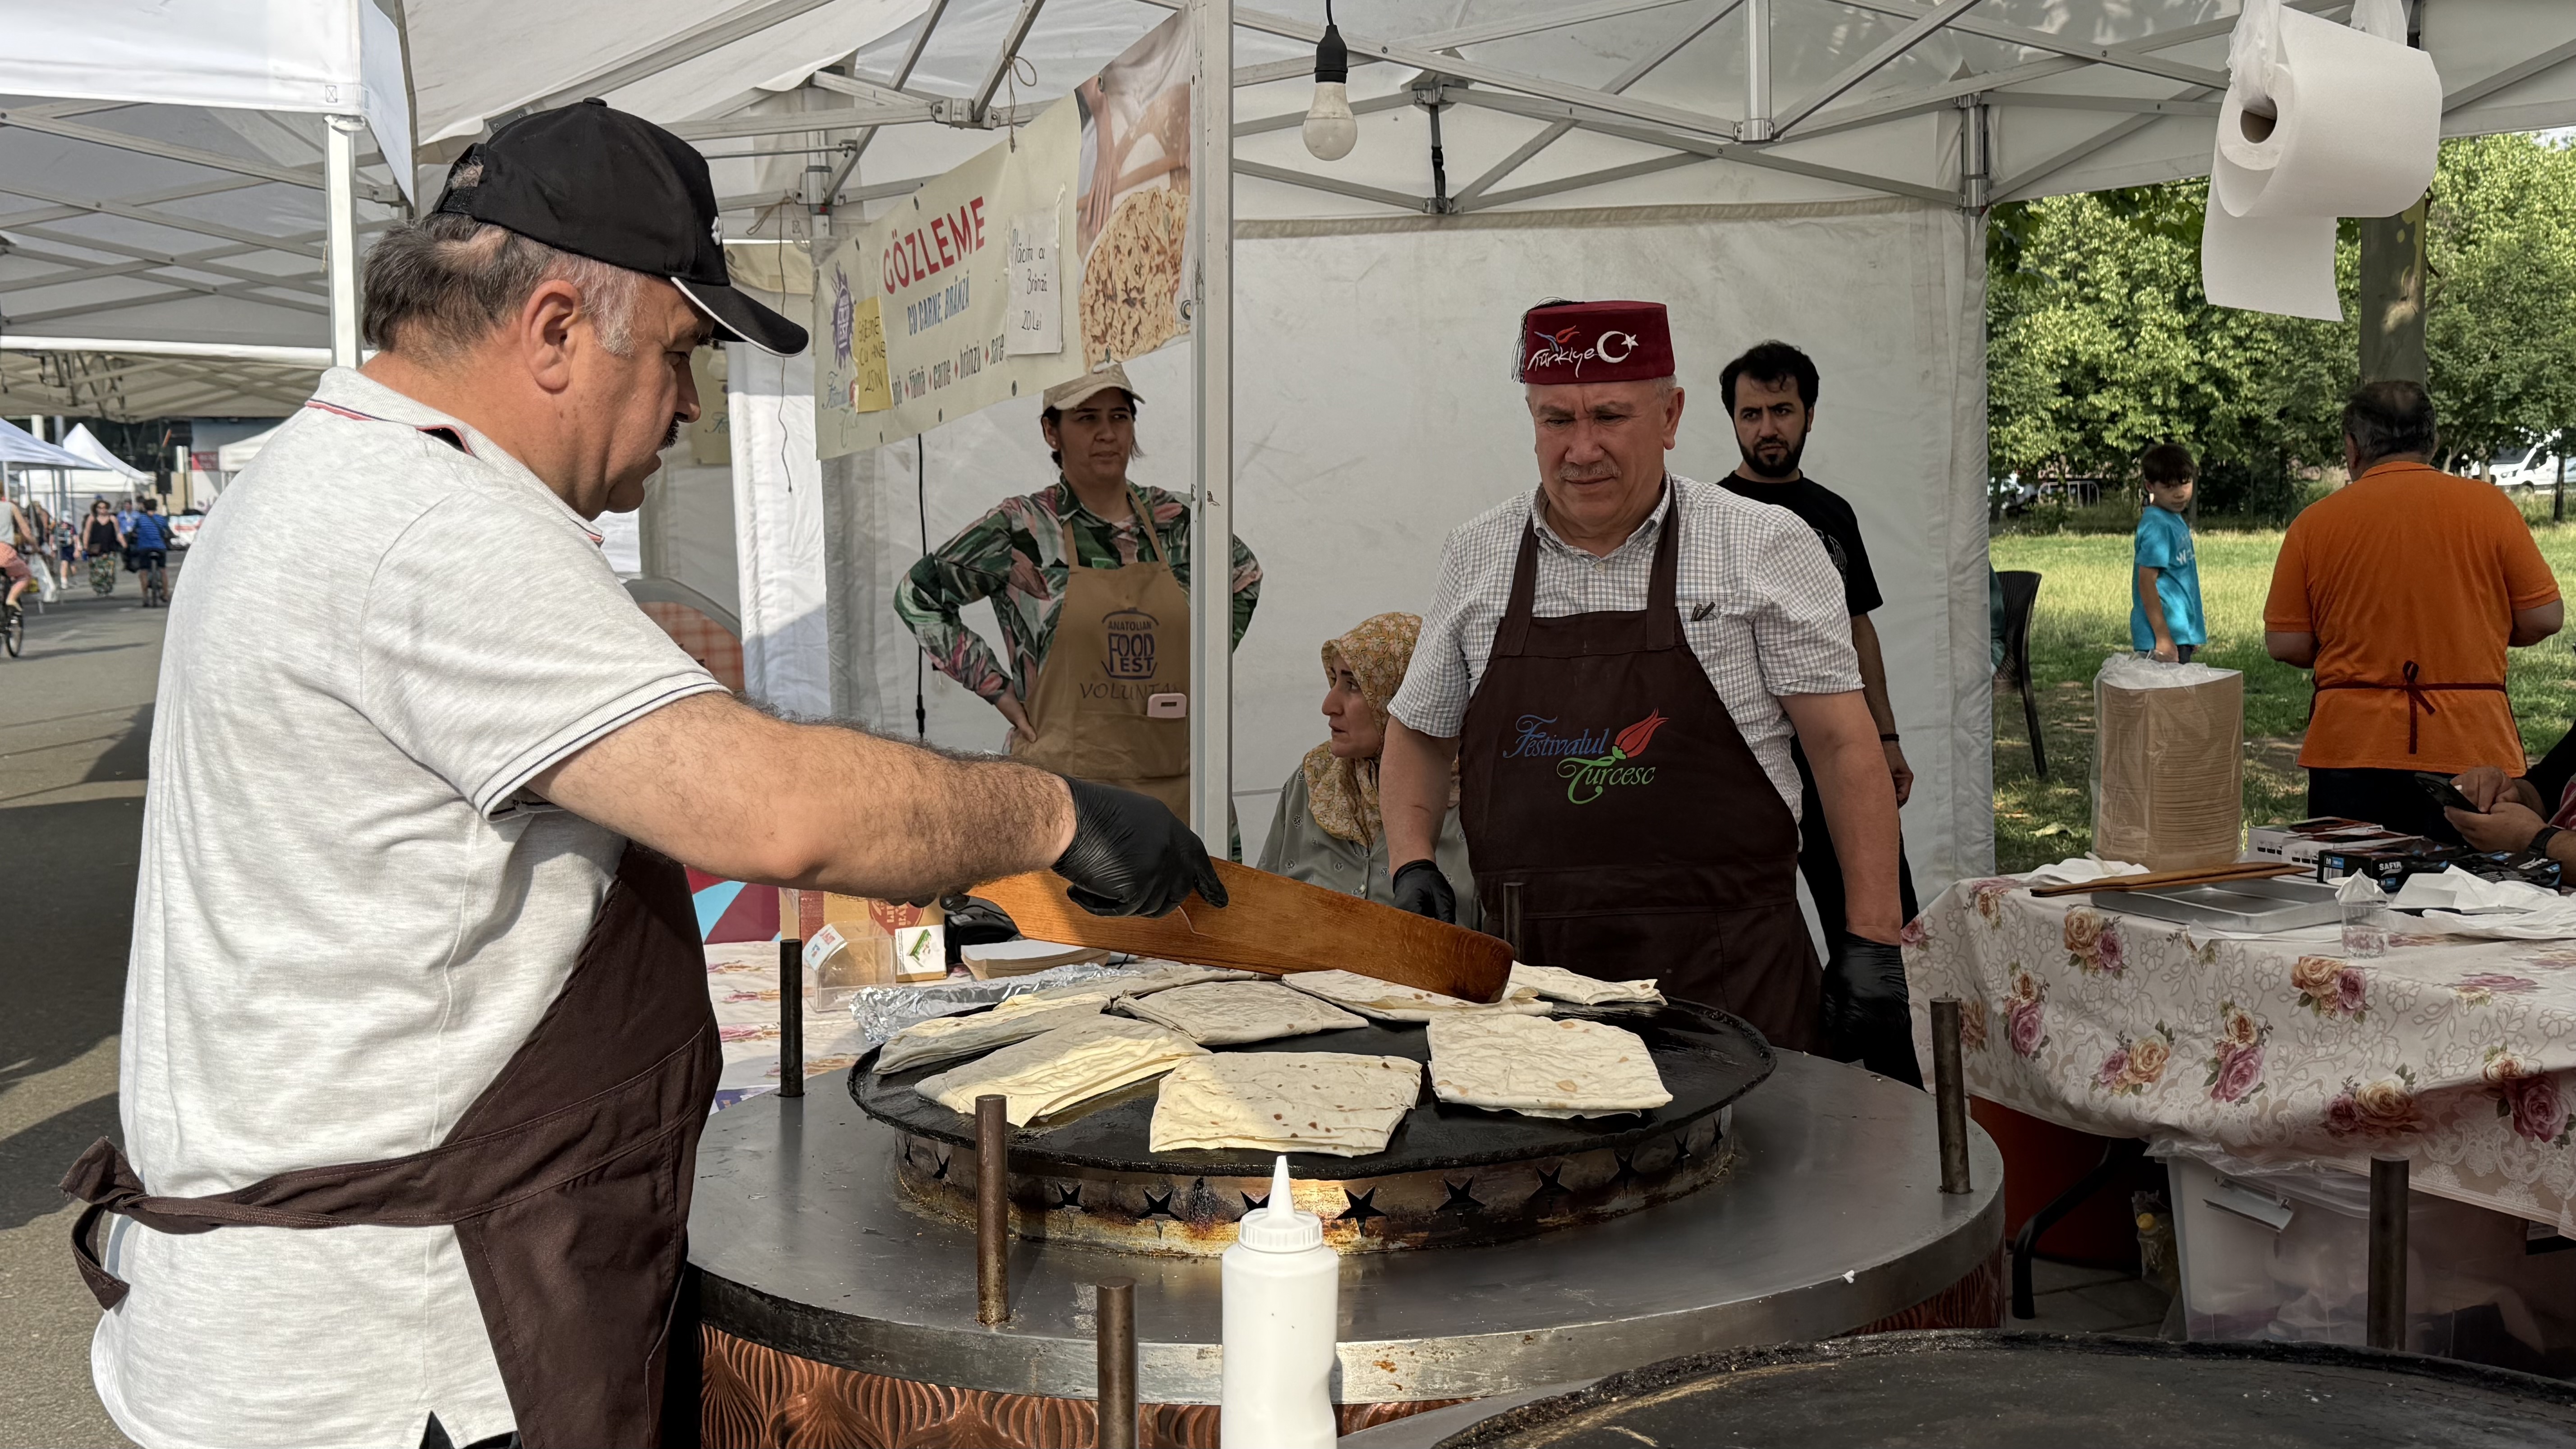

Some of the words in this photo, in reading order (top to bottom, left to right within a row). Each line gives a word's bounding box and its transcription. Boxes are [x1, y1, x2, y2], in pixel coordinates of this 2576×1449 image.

[883, 196, 984, 294] GÖZLEME
[907, 304, 918, 336] CU
[944, 268, 970, 320] BRÂNZĂ
[1021, 310, 1031, 331] 20
[989, 334, 1004, 366] sare
[1108, 621, 1152, 630] ANATOLIAN
[1108, 633, 1155, 672] FOOD
[1503, 714, 1610, 758] Festivalul
[1556, 756, 1656, 805] Turcesc
